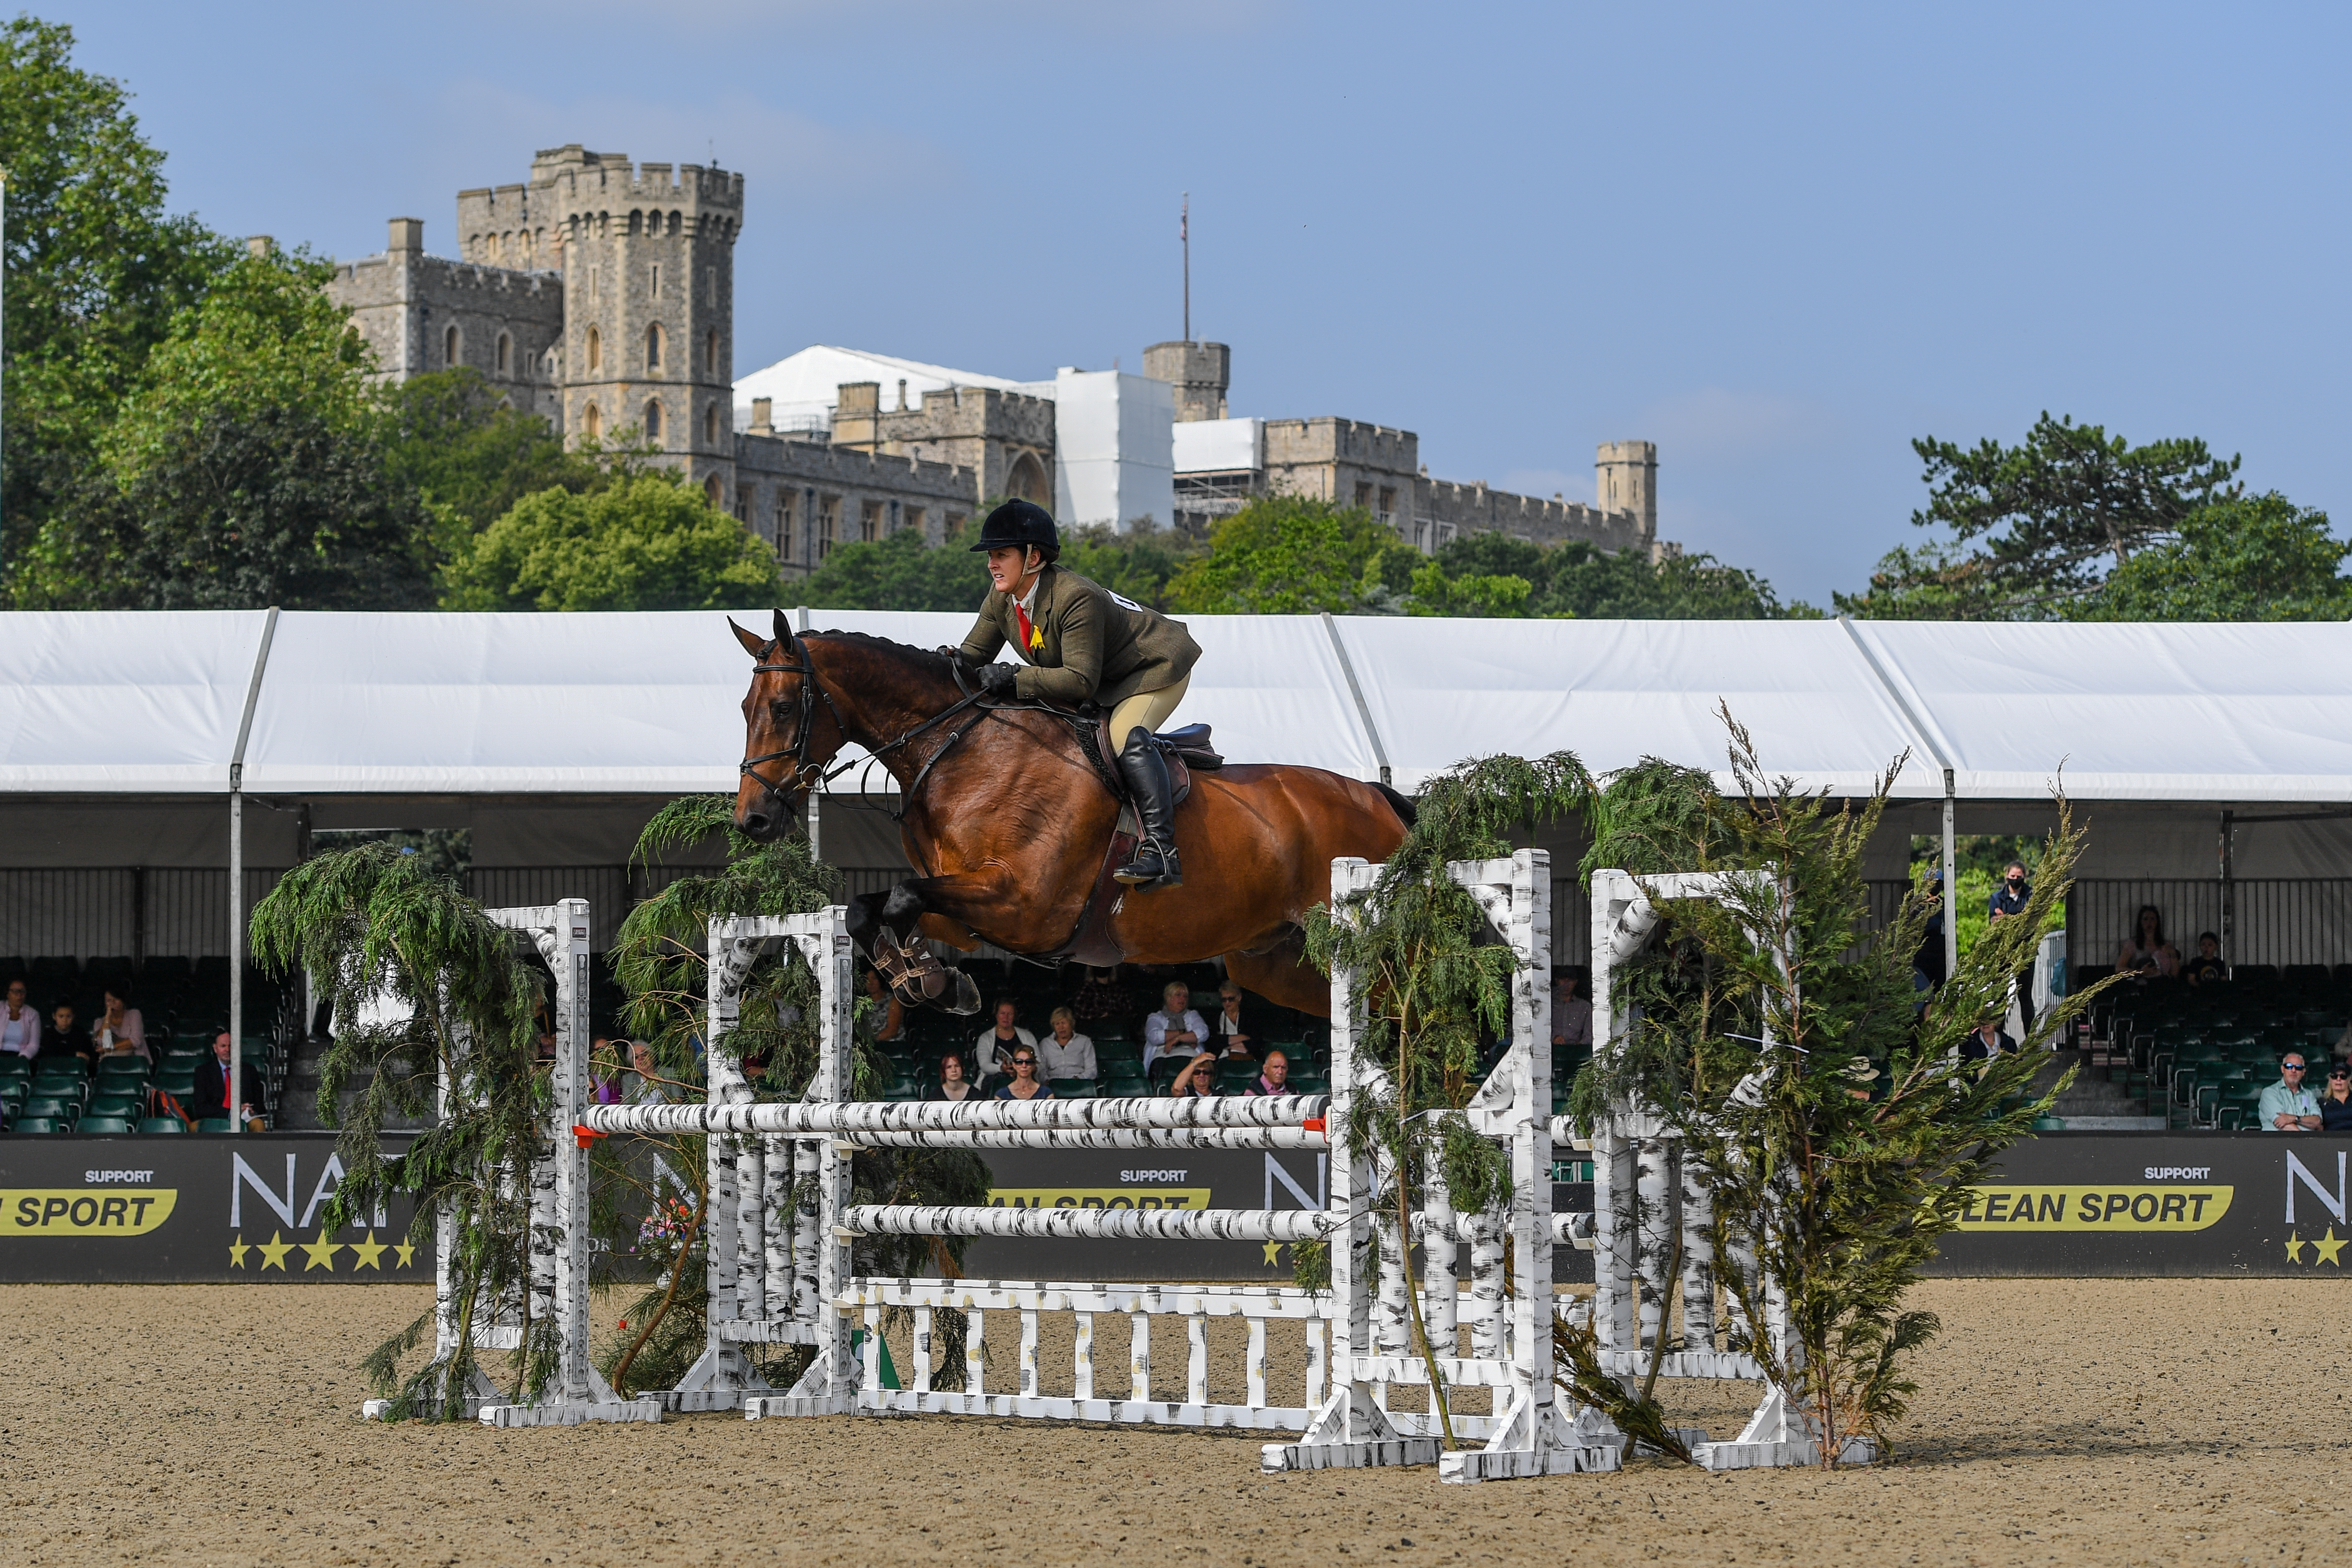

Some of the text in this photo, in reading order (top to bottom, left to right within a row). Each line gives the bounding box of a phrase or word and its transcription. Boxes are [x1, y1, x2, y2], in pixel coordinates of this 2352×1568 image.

[85, 1170, 153, 1183] SUPPORT
[1120, 1170, 1187, 1183] SUPPORT
[2144, 1167, 2210, 1180] SUPPORT
[15, 1197, 155, 1227] SPORT
[2078, 1194, 2212, 1222] SPORT
